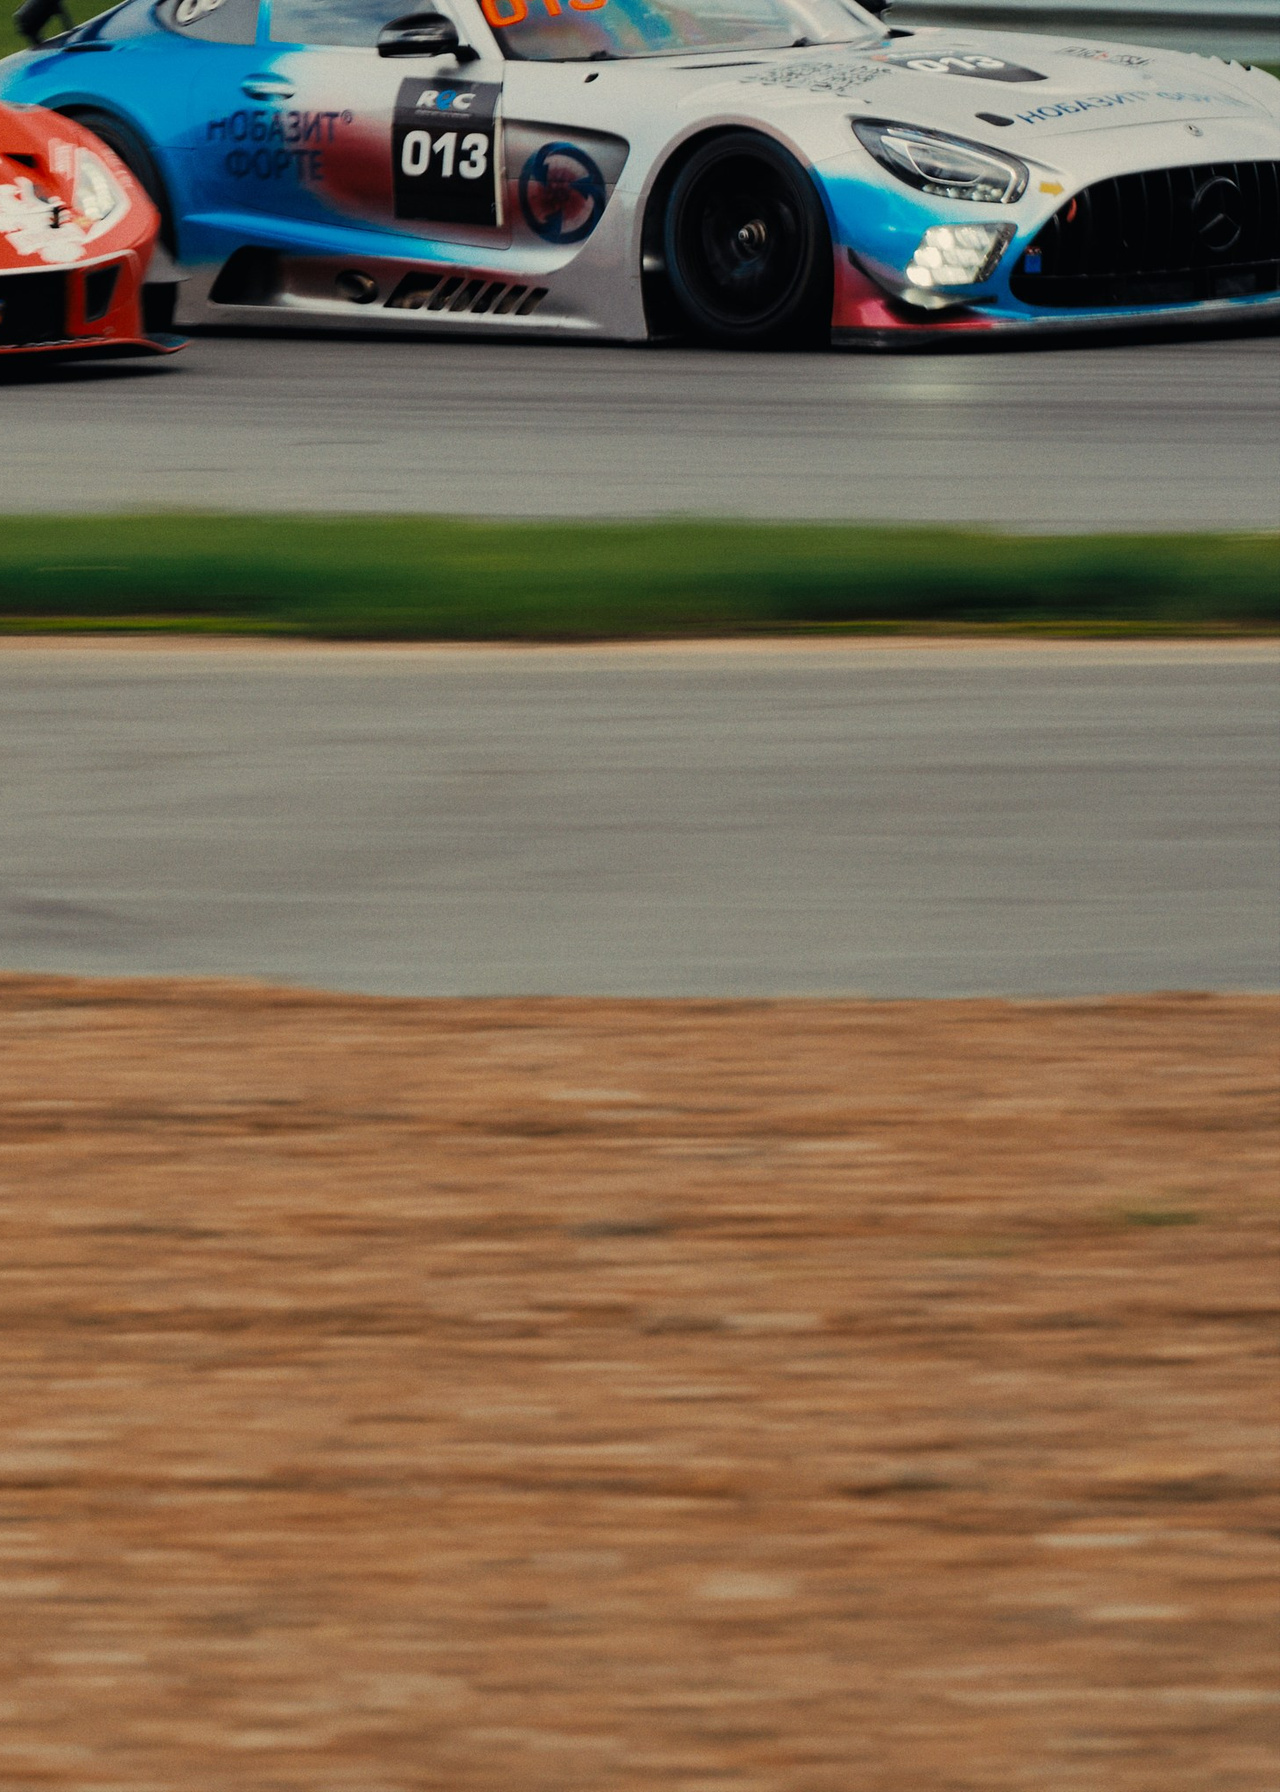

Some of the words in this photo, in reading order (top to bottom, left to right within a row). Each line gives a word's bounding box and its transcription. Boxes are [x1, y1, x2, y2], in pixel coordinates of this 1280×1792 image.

[907, 56, 1005, 73] 013
[224, 148, 324, 182] ФОРТЕ
[401, 130, 490, 180] 013
